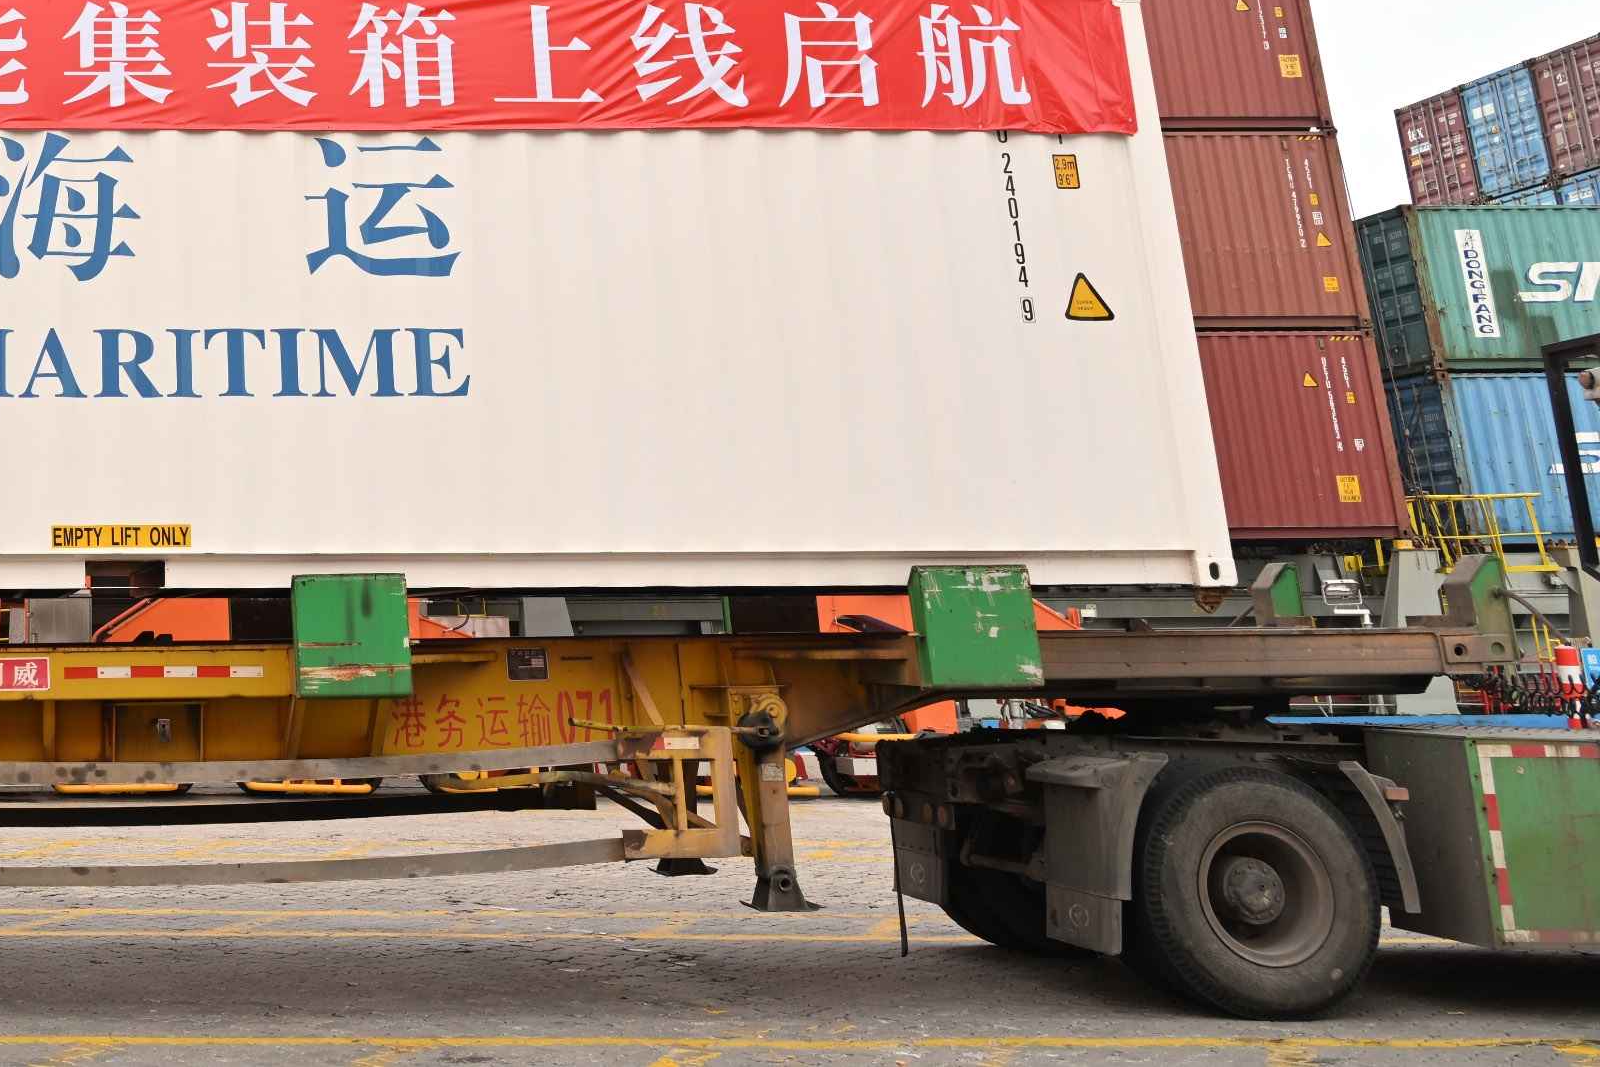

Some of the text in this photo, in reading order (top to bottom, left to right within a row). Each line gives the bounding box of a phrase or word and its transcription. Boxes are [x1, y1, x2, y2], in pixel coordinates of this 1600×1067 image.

[1463, 249, 1495, 334] DONGFANG
[53, 526, 189, 546] EMPTY LIFT ONLY
